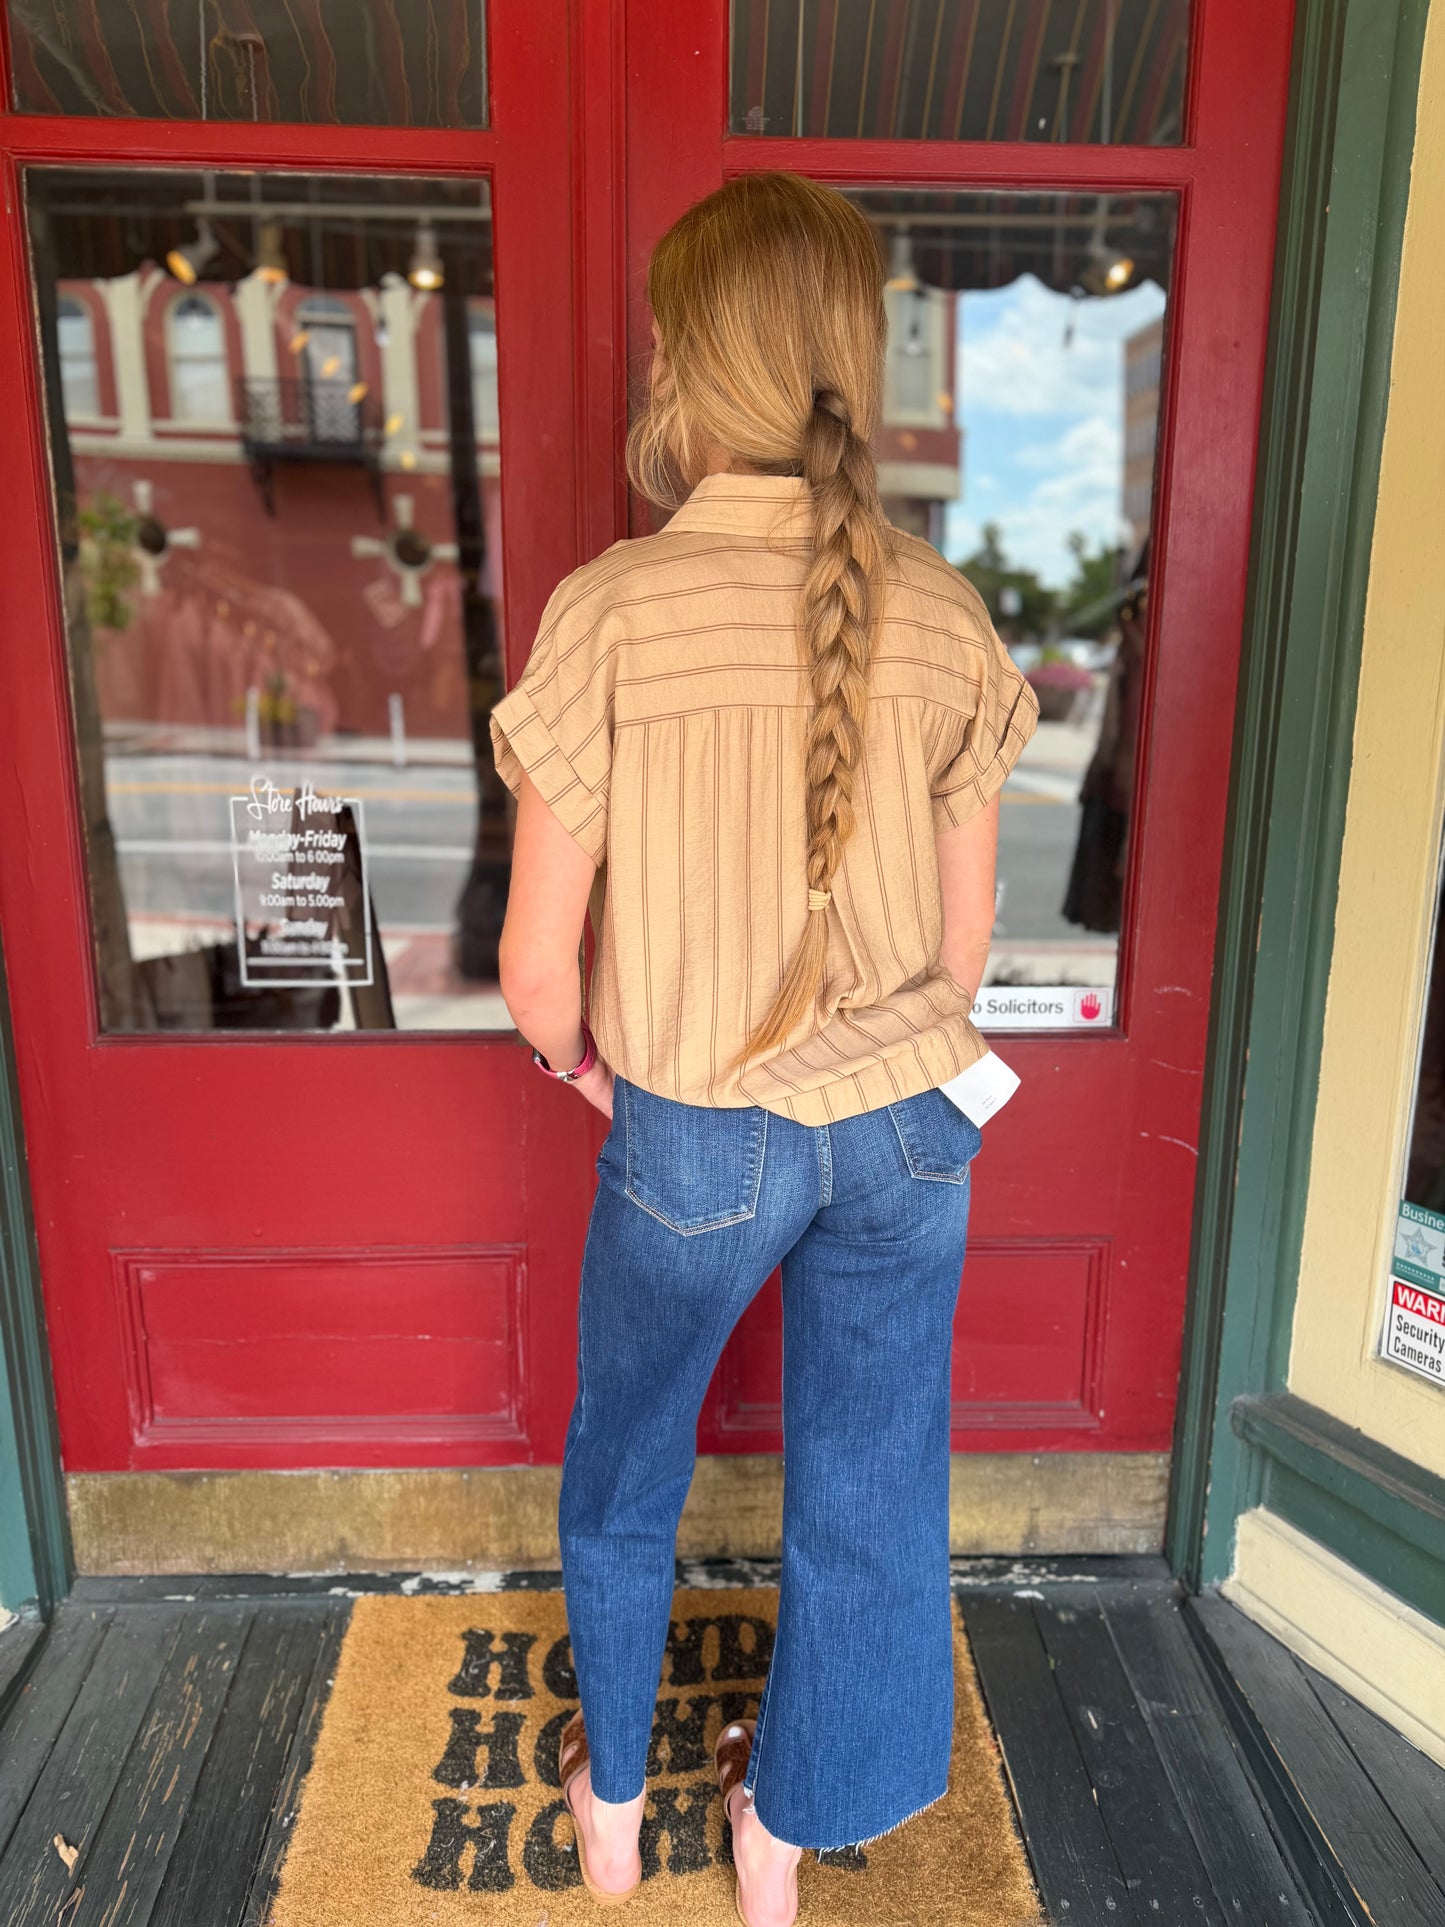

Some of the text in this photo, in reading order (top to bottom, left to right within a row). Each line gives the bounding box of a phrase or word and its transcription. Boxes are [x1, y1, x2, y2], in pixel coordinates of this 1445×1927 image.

[247, 775, 343, 821] Store Hours
[249, 829, 347, 851] Monday-Friday
[295, 850, 306, 863] to
[271, 872, 331, 893] Saturday
[296, 895, 307, 907] to
[986, 999, 1064, 1014] Solicitors
[1402, 1203, 1445, 1231] Busine
[1396, 1314, 1445, 1354] Security
[1394, 1336, 1442, 1373] Cameras
